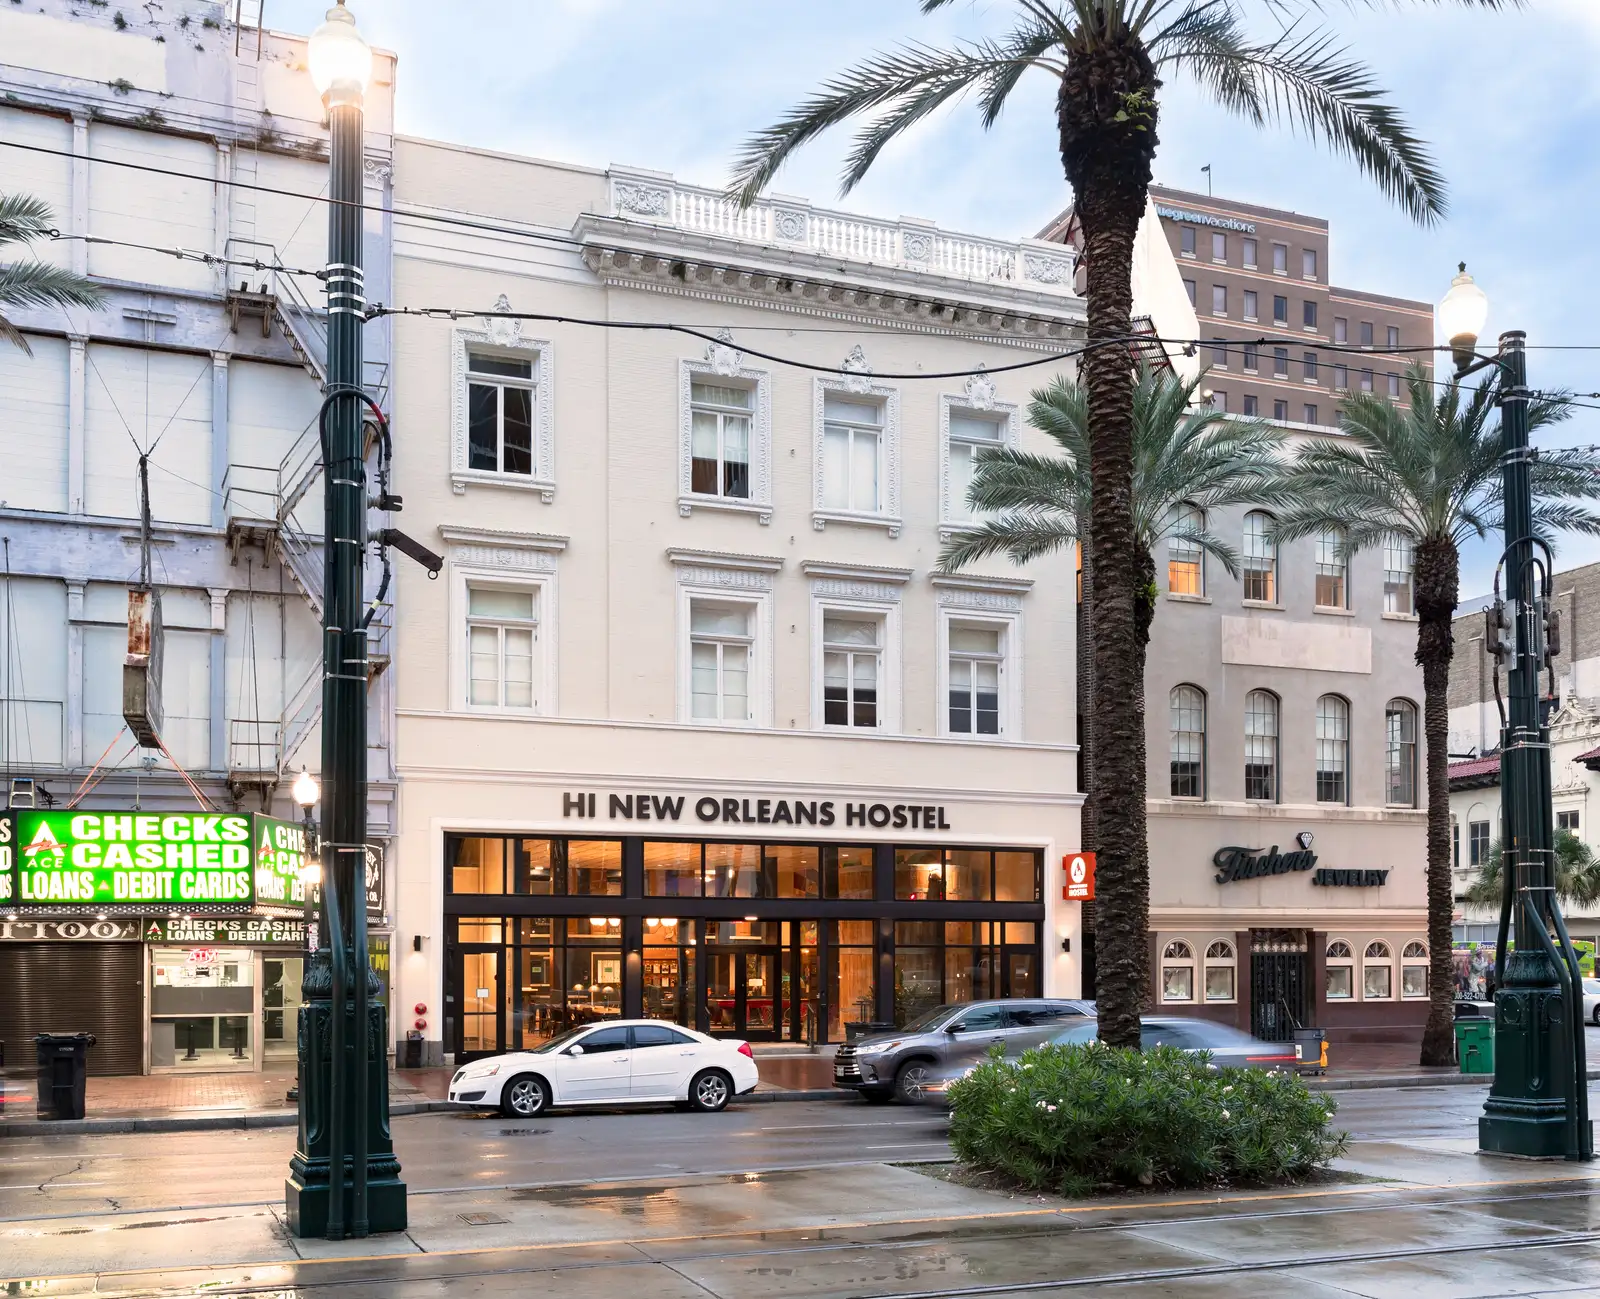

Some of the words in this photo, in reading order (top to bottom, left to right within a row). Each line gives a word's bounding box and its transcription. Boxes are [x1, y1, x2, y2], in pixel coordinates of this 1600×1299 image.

[1155, 203, 1255, 234] luegreenvacations
[563, 792, 596, 818] HI
[609, 793, 685, 820] NEW
[695, 797, 835, 827] ORLEANS
[846, 803, 951, 829] HOSTEL
[71, 815, 249, 842] CHECKS
[27, 857, 64, 868] ACE
[71, 843, 250, 869] CASHED
[21, 871, 95, 900] LOANS
[113, 871, 175, 899] DEBIT
[179, 871, 250, 899] CARDS
[1312, 868, 1388, 887] JEWELRY
[167, 920, 241, 931] CHECKS
[247, 920, 305, 931] CASHE
[167, 930, 215, 941] LOANS
[228, 931, 269, 941] DEBIT
[272, 931, 304, 942] CAR
